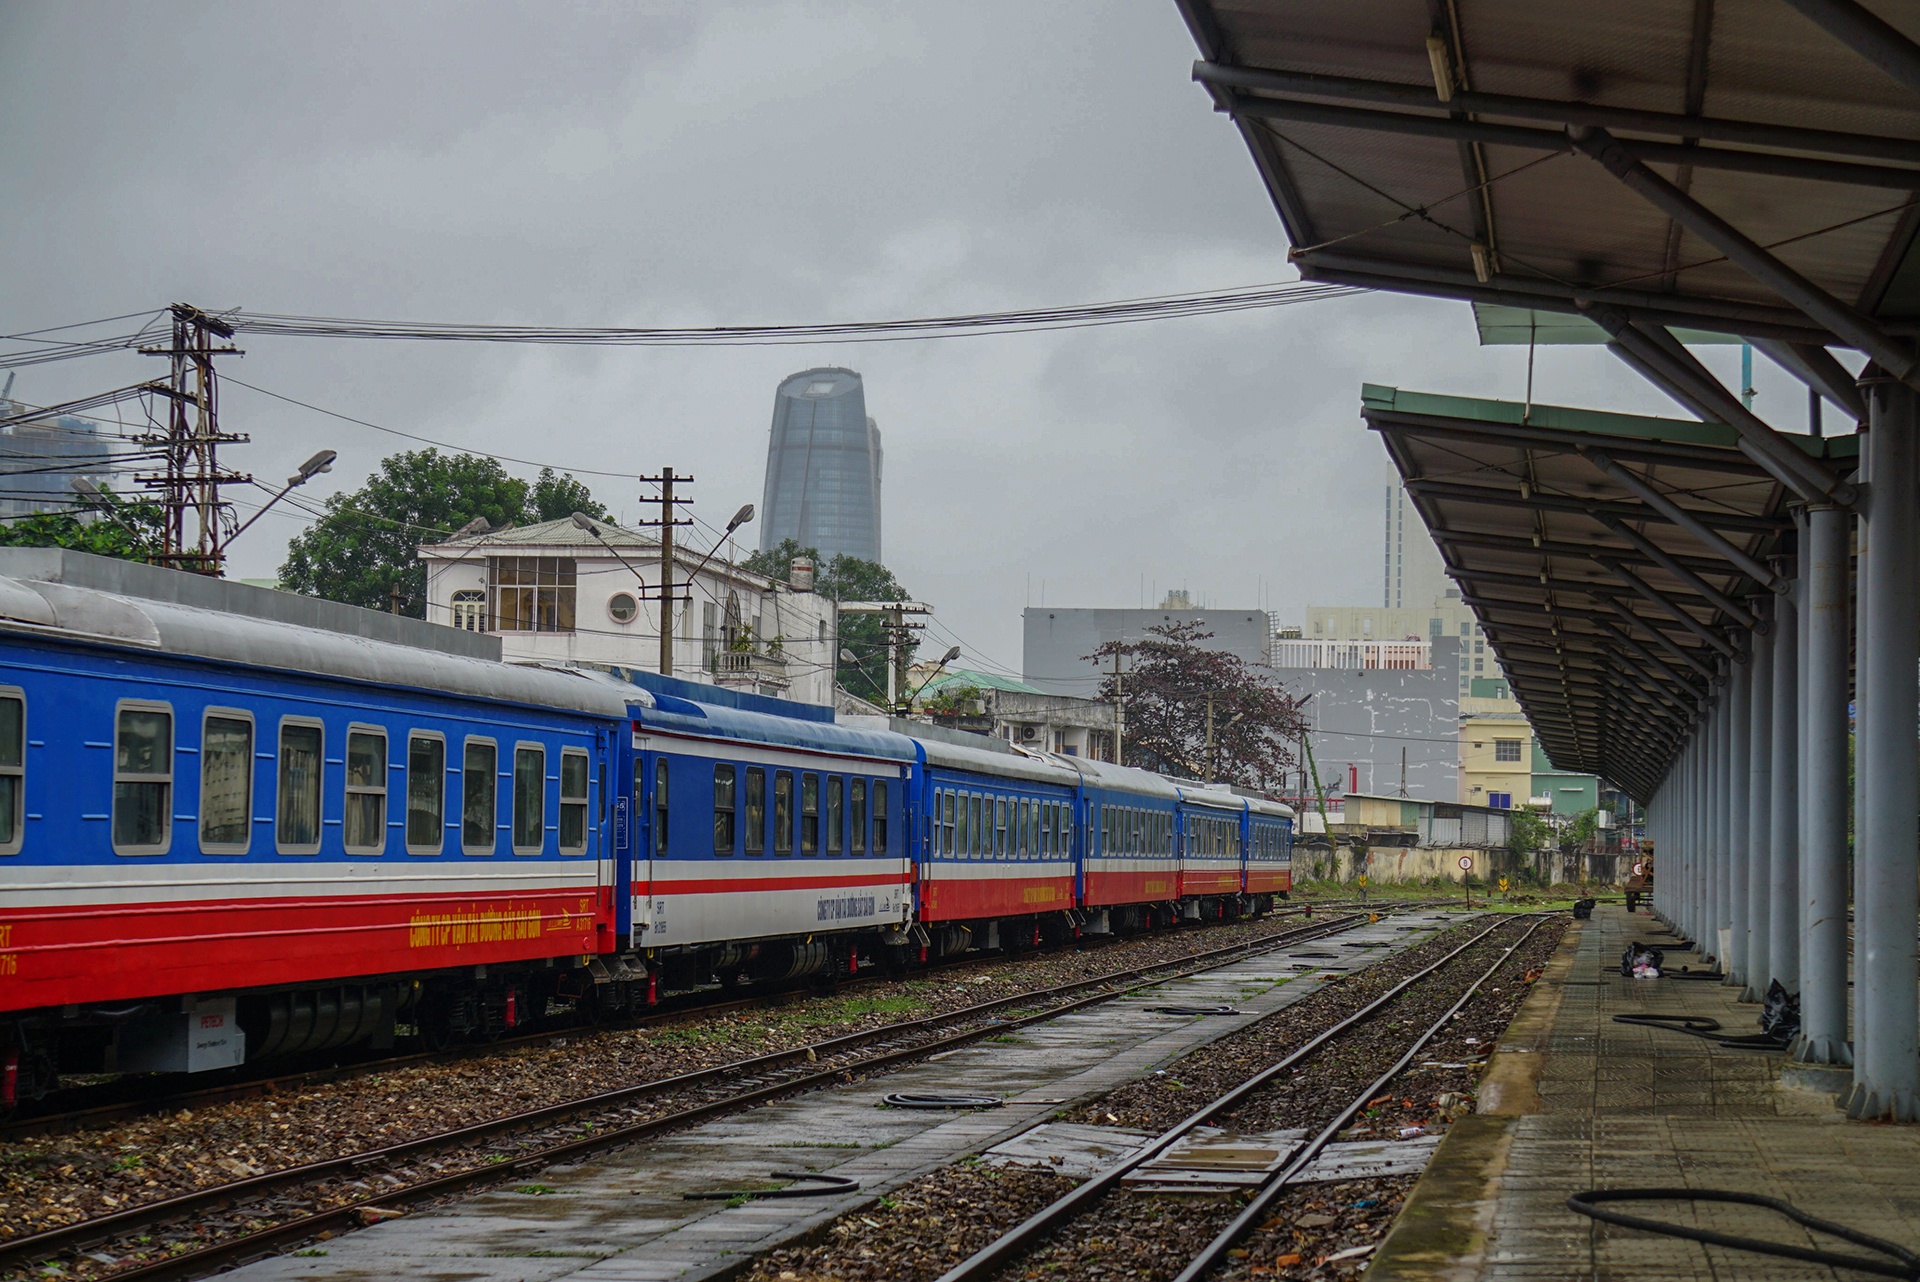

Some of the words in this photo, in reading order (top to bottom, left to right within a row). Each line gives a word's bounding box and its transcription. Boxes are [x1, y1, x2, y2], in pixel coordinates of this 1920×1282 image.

[579, 899, 589, 913] SRT
[410, 908, 430, 948] CÔNG
[431, 914, 440, 946] TY
[441, 914, 451, 945] CP
[452, 906, 466, 951] VẬN
[467, 902, 479, 944] TẢI
[480, 904, 502, 942] ĐƯỜNG
[503, 900, 515, 941] SẮT
[516, 903, 527, 940] SÀI
[528, 902, 541, 939] GÒN
